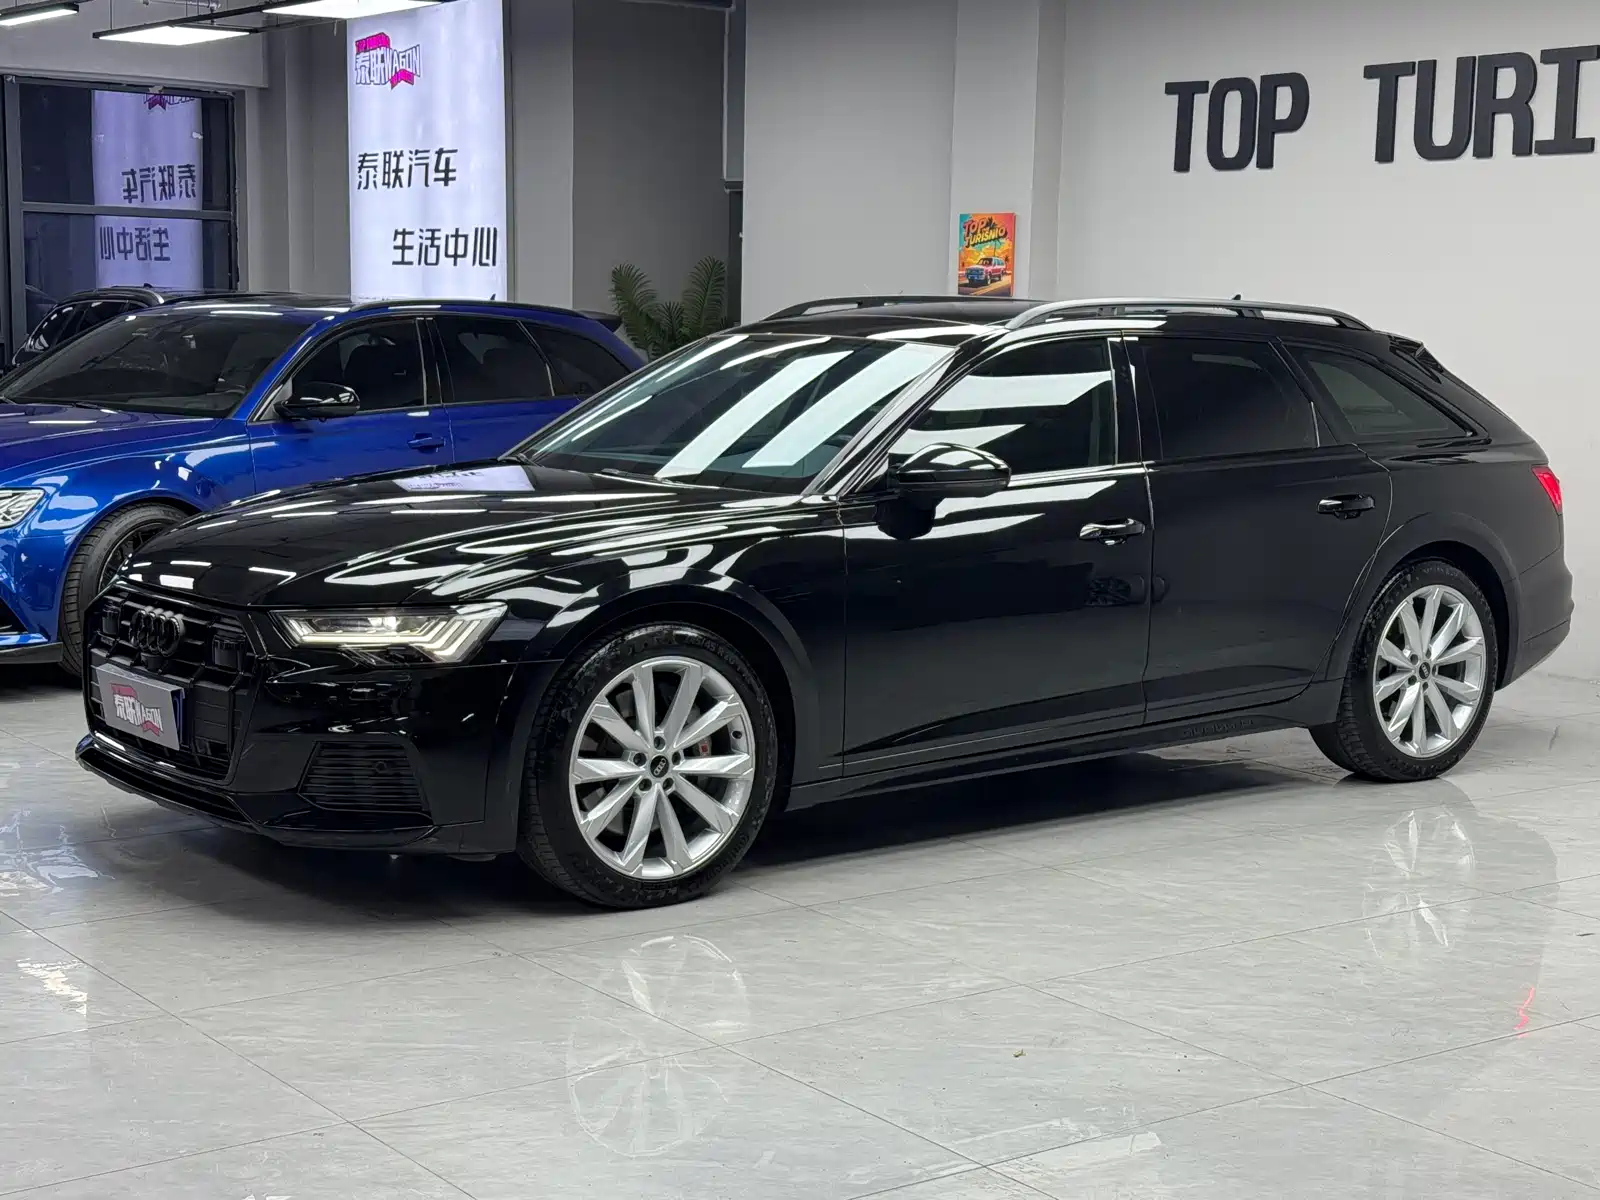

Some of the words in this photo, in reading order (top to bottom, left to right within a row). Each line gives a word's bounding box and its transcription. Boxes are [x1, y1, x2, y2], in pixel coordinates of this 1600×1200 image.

[1164, 72, 1310, 173] TOP
[1363, 44, 1600, 163] TURI
[357, 148, 459, 190] 泰联汽车
[391, 226, 498, 267] 生活中心
[963, 217, 988, 237] TOP
[965, 226, 1008, 248] TURISMO
